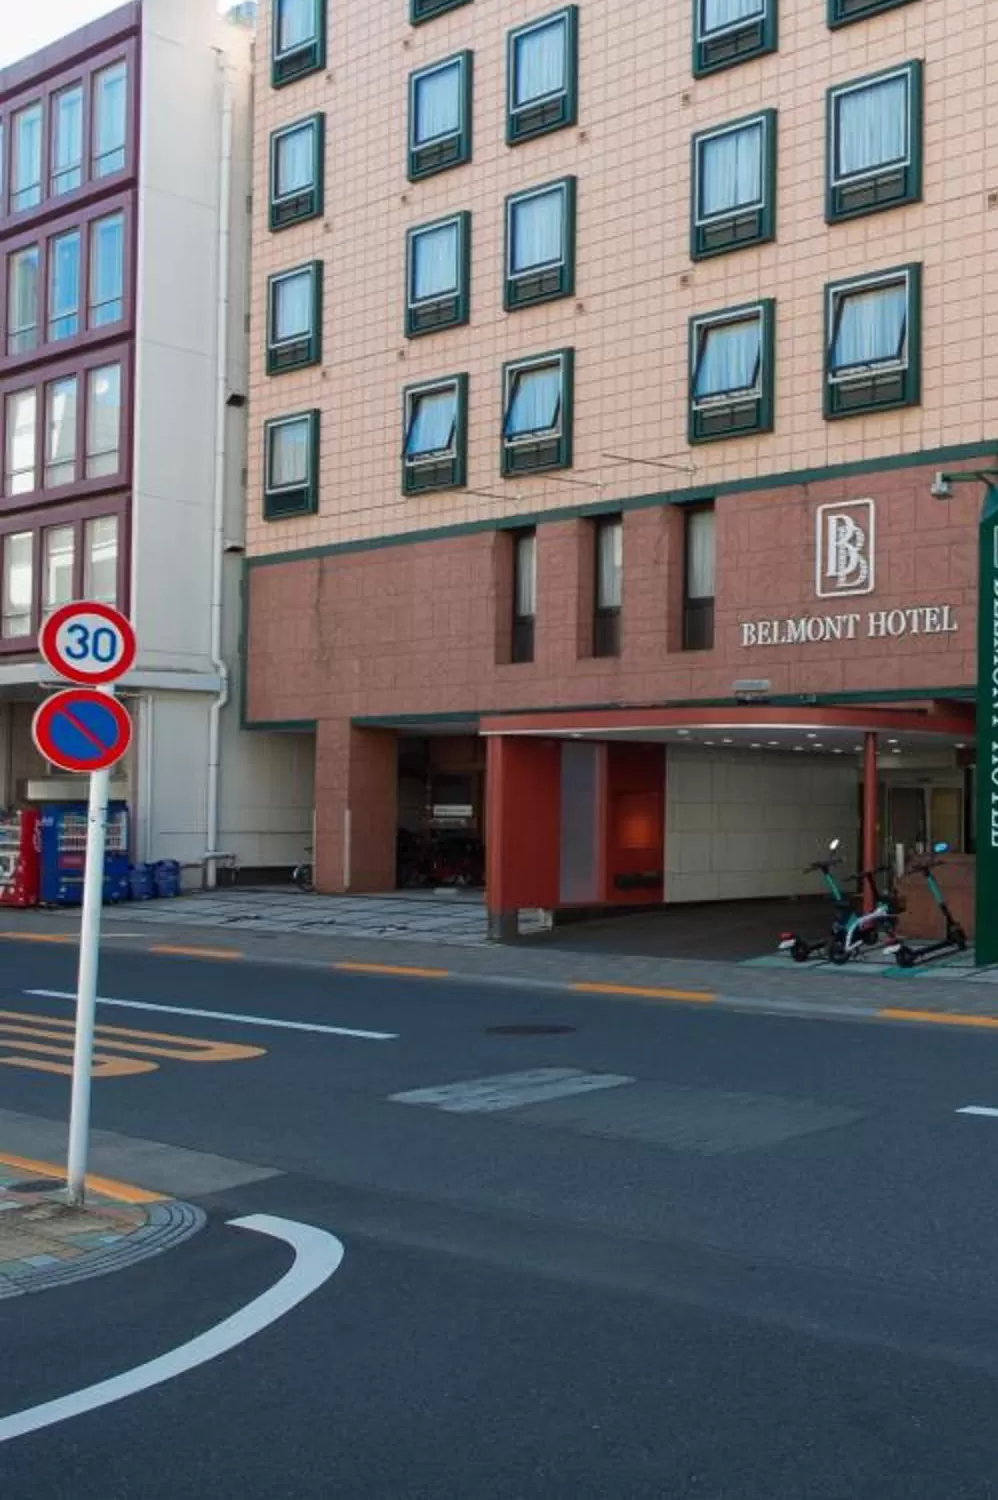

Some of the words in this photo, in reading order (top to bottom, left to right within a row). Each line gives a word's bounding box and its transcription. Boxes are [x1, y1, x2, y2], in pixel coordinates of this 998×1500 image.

[65, 624, 117, 662] 30
[741, 614, 860, 646] BELMONT
[868, 606, 957, 637] HOTEL
